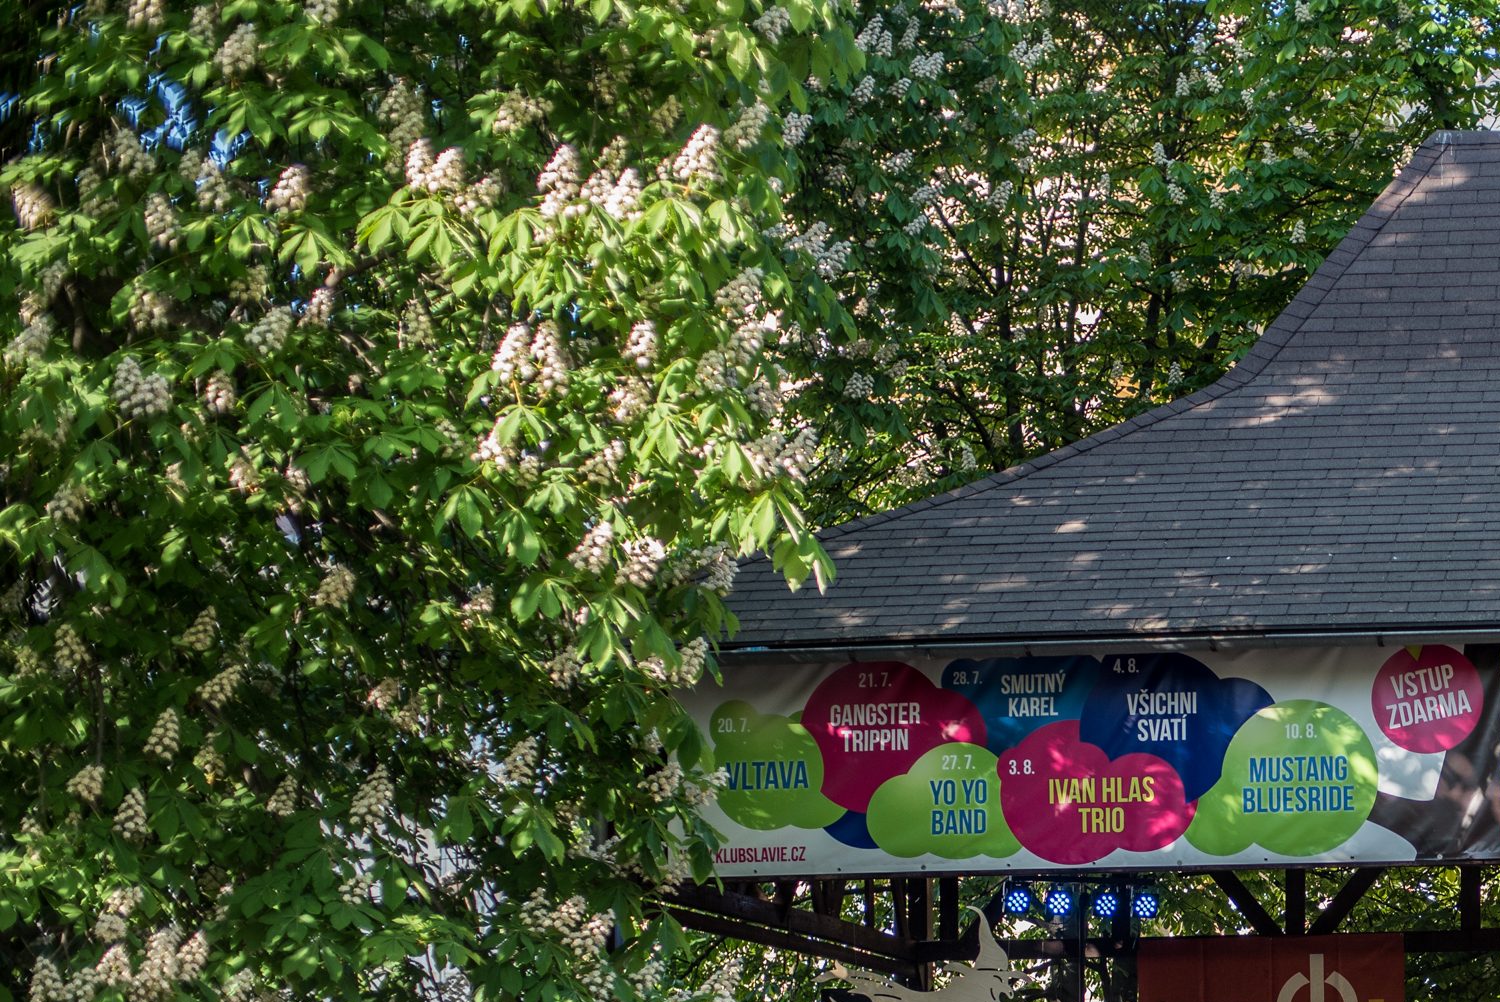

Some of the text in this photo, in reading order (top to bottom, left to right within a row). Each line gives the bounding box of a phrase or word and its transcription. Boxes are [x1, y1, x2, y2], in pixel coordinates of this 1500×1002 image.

[1001, 671, 1066, 694] SMUTNÝ
[1390, 664, 1454, 699] VSTUP
[829, 702, 921, 727] GANGSTER
[1008, 697, 1059, 718] KAREL
[1127, 689, 1197, 716] VŠICHNI
[1386, 689, 1472, 730] ZDARMA
[841, 728, 909, 753] TRIPPIN
[1137, 714, 1187, 742] SVATÍ
[726, 761, 809, 790] VLTAVA
[1249, 755, 1347, 783] MUSTANG
[930, 779, 987, 805] YO YO
[1049, 776, 1155, 804] IVAN HLAS
[1242, 785, 1355, 814] BLUESRIDE
[931, 809, 986, 835] BAND
[1078, 807, 1125, 833] TRIO
